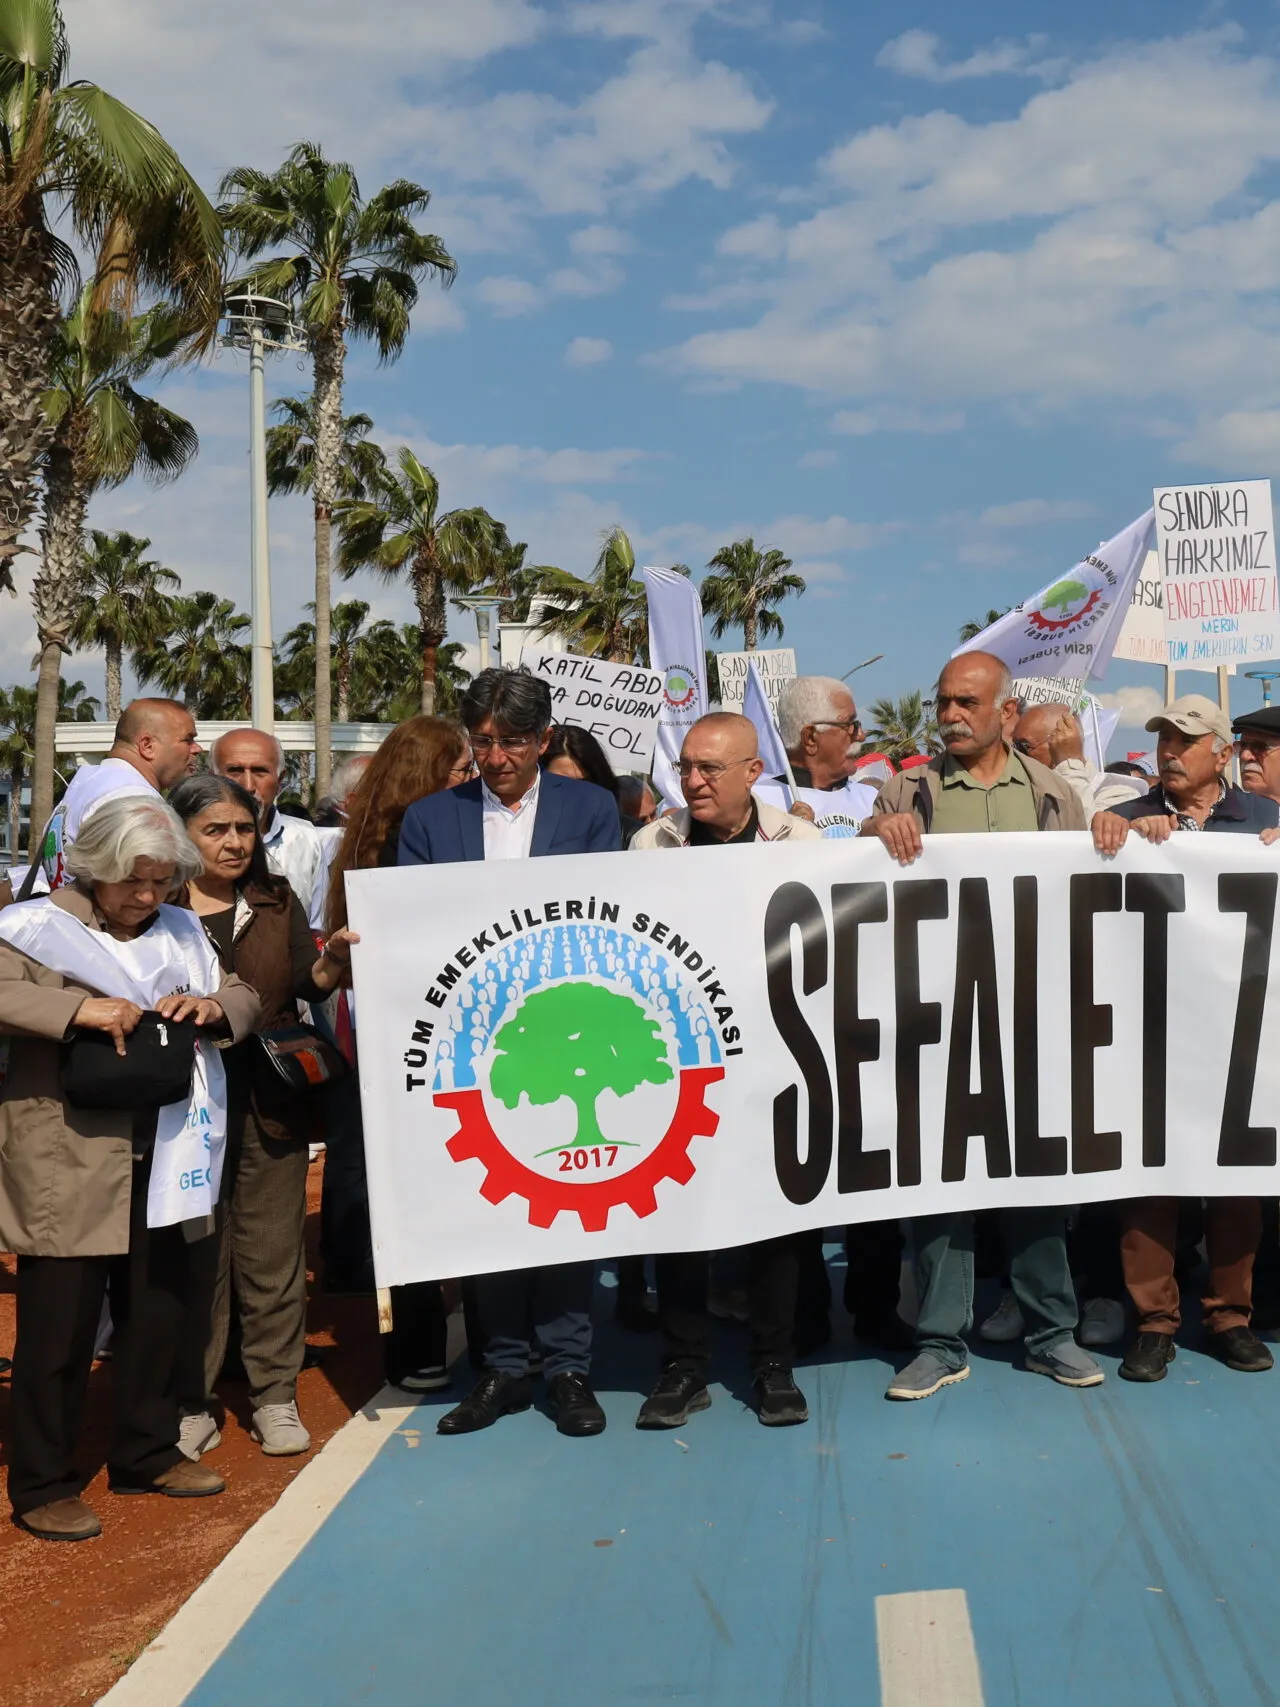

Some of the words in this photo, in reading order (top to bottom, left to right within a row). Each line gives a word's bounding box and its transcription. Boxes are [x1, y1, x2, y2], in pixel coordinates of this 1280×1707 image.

[1159, 486, 1248, 532] SENDİKA
[537, 656, 602, 683] KATİL
[610, 670, 662, 695] ABD
[814, 814, 855, 830] KLİLERİN
[404, 1019, 435, 1092] TÜM
[424, 896, 620, 1009] EMEKLİLERİN
[632, 912, 744, 1057] SENDİKASI
[764, 872, 1186, 1205] SEFALET
[558, 1145, 620, 1172] 2017
